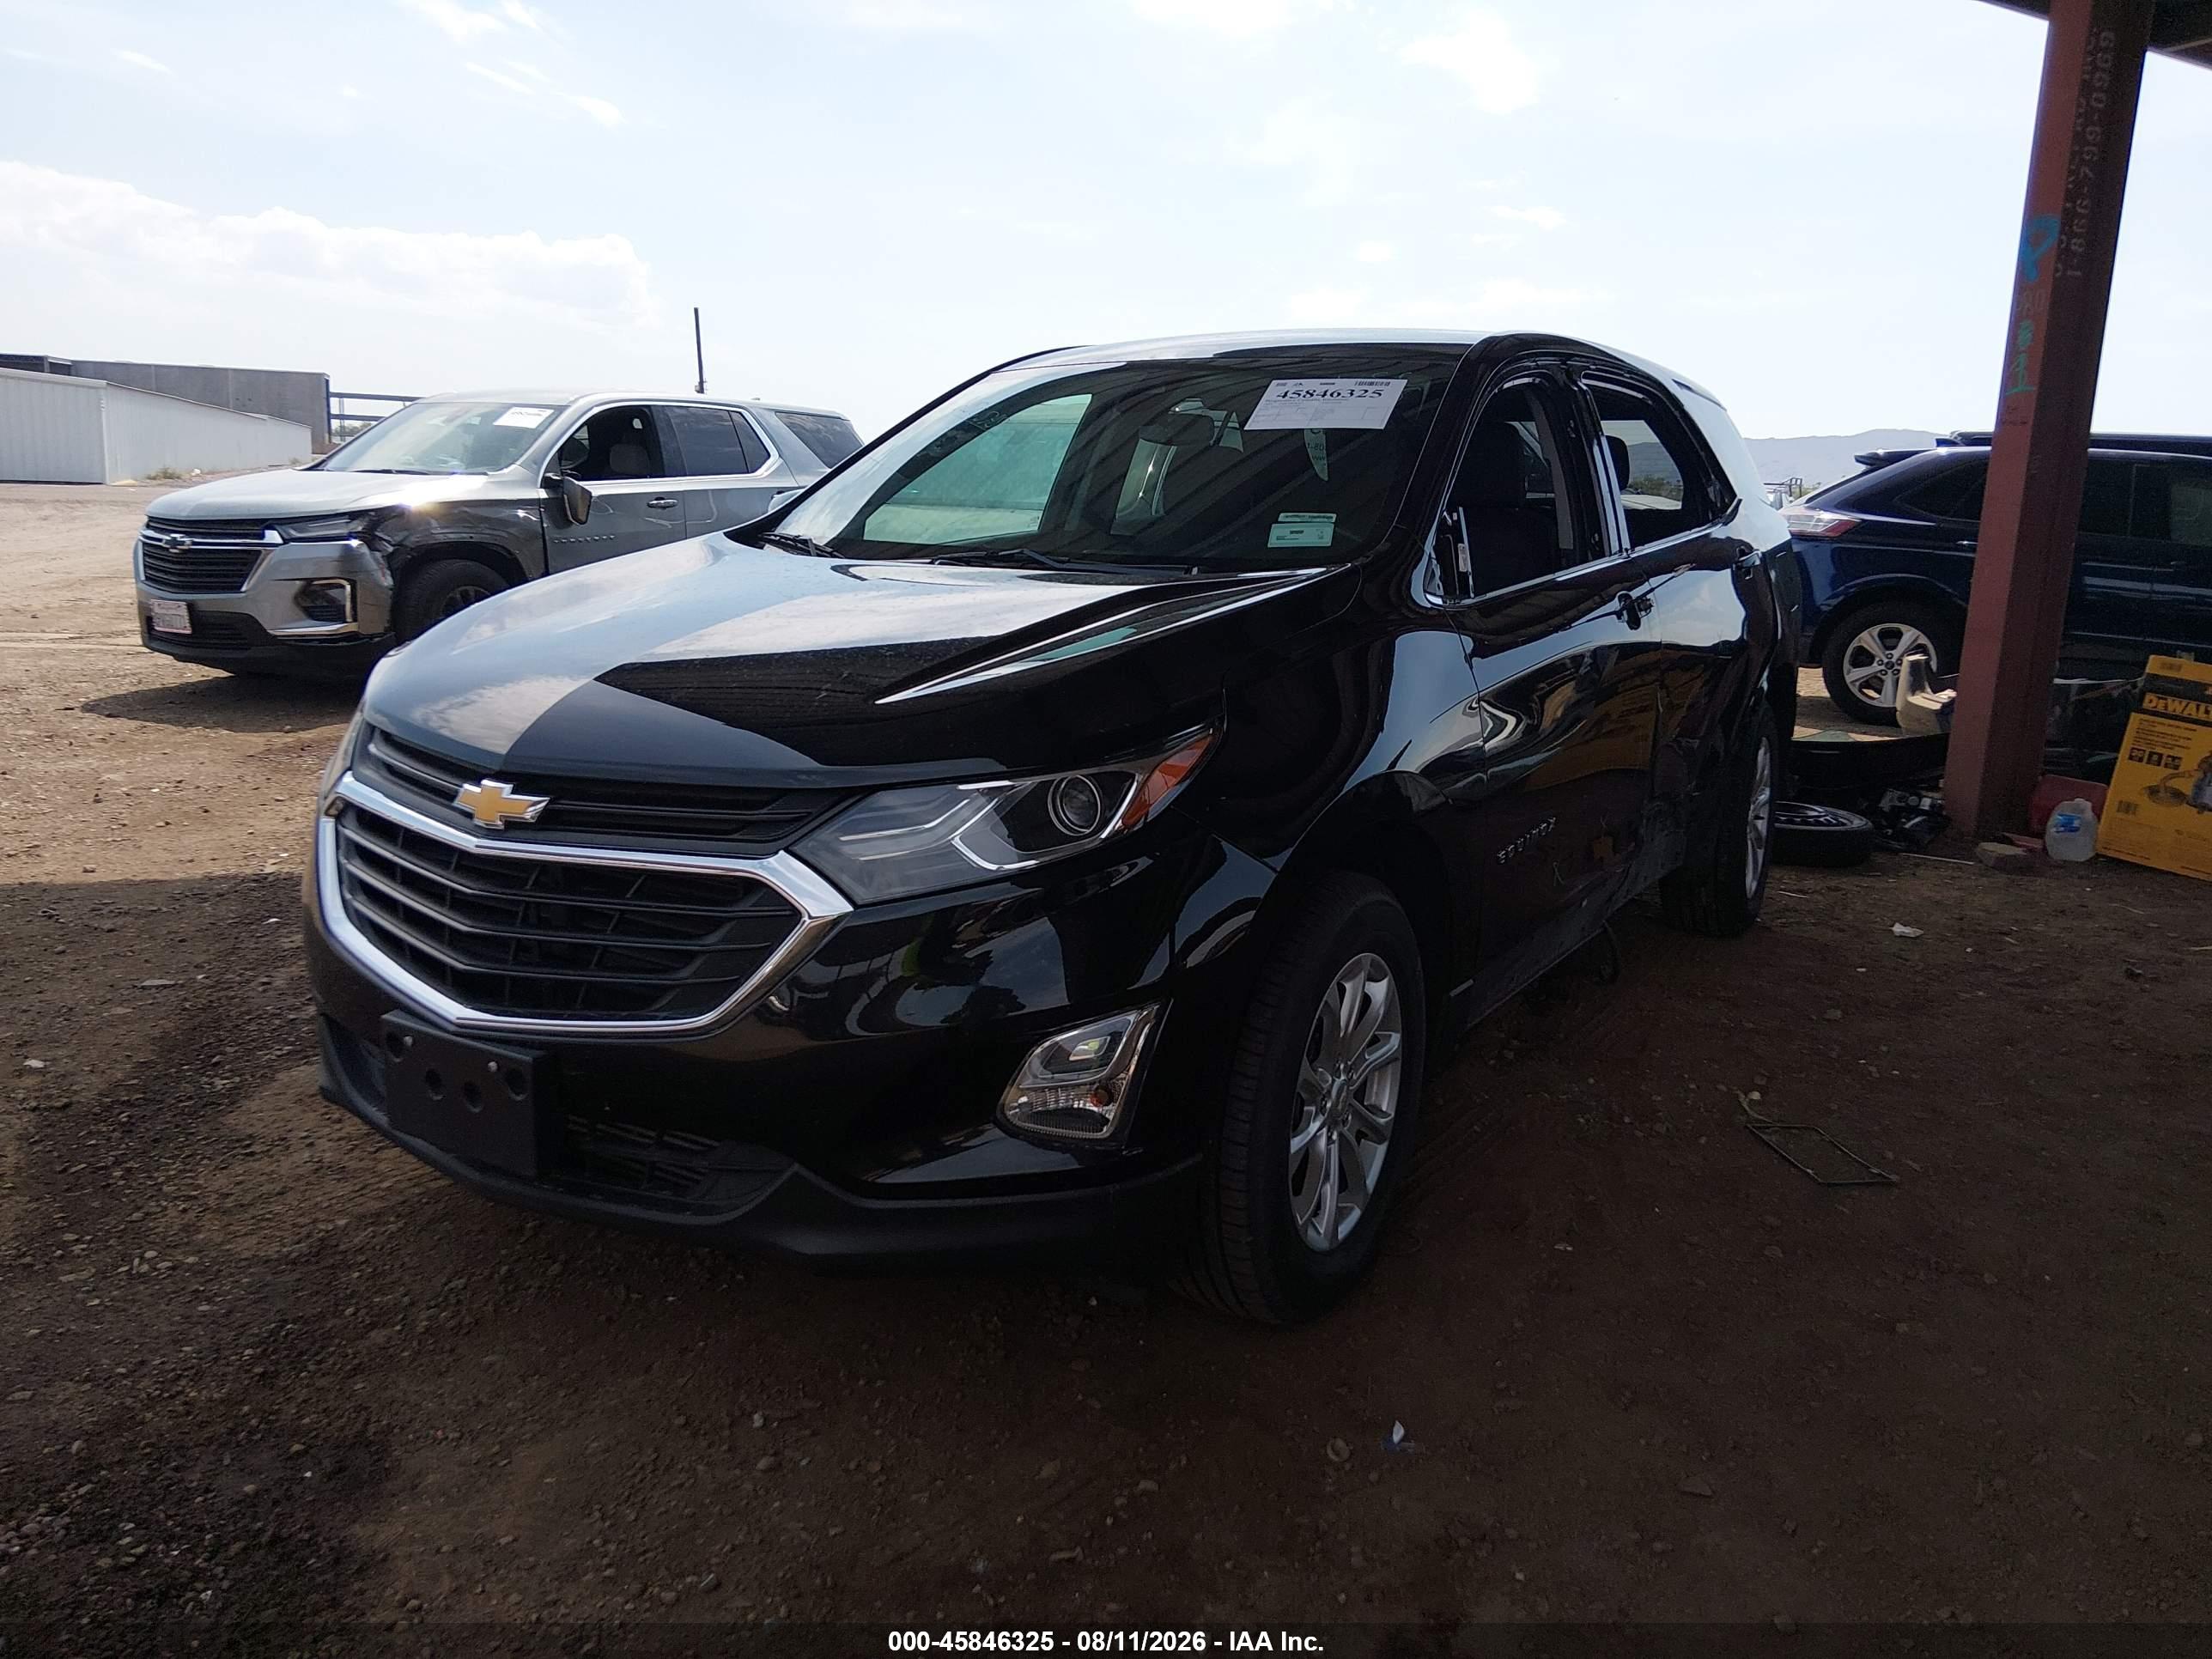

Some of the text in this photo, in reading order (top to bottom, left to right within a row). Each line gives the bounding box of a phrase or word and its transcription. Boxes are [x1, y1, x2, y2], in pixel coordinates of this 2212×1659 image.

[2067, 31, 2116, 278] 1-866-799-0969
[1276, 388, 1384, 399] 45846325
[1497, 817, 1556, 864] EQUINOX
